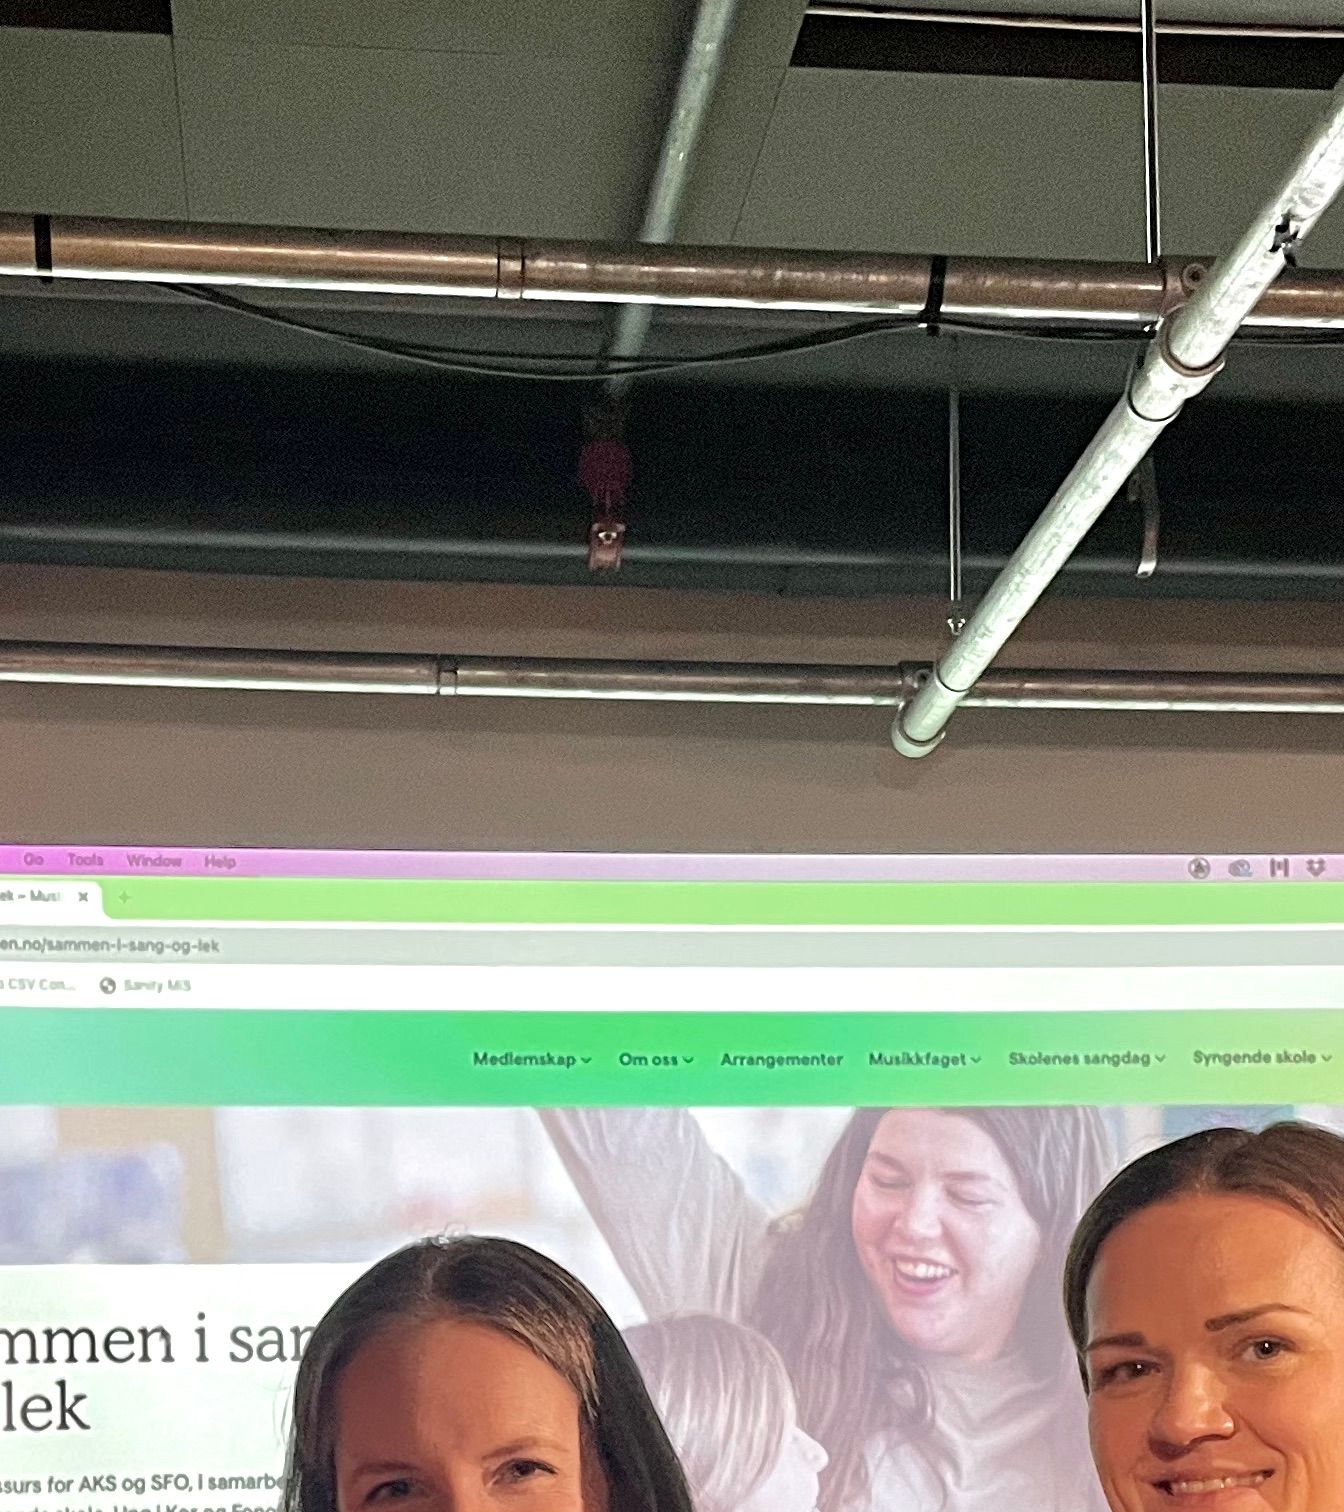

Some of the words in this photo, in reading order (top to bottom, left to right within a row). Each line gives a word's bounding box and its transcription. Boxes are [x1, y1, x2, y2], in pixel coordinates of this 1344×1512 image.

[23, 852, 44, 866] Go
[67, 853, 104, 867] Tools
[126, 854, 183, 868] Window
[204, 855, 237, 870] Help
[472, 1051, 577, 1069] Medlemskap
[618, 1052, 648, 1066] Om
[651, 1054, 679, 1066] oss
[720, 1052, 844, 1070] Arrangementer
[868, 1051, 967, 1068] Musikkfaget
[1008, 1051, 1080, 1066] Skolenes
[1083, 1051, 1151, 1068] sangdag
[1192, 1050, 1272, 1068] Syngende
[1275, 1049, 1317, 1064] skole
[193, 1311, 210, 1363] i
[1, 1379, 92, 1433] lek
[47, 1476, 75, 1494] for
[78, 1475, 117, 1493] AKS
[121, 1477, 146, 1495] og
[150, 1473, 194, 1493] SFO,
